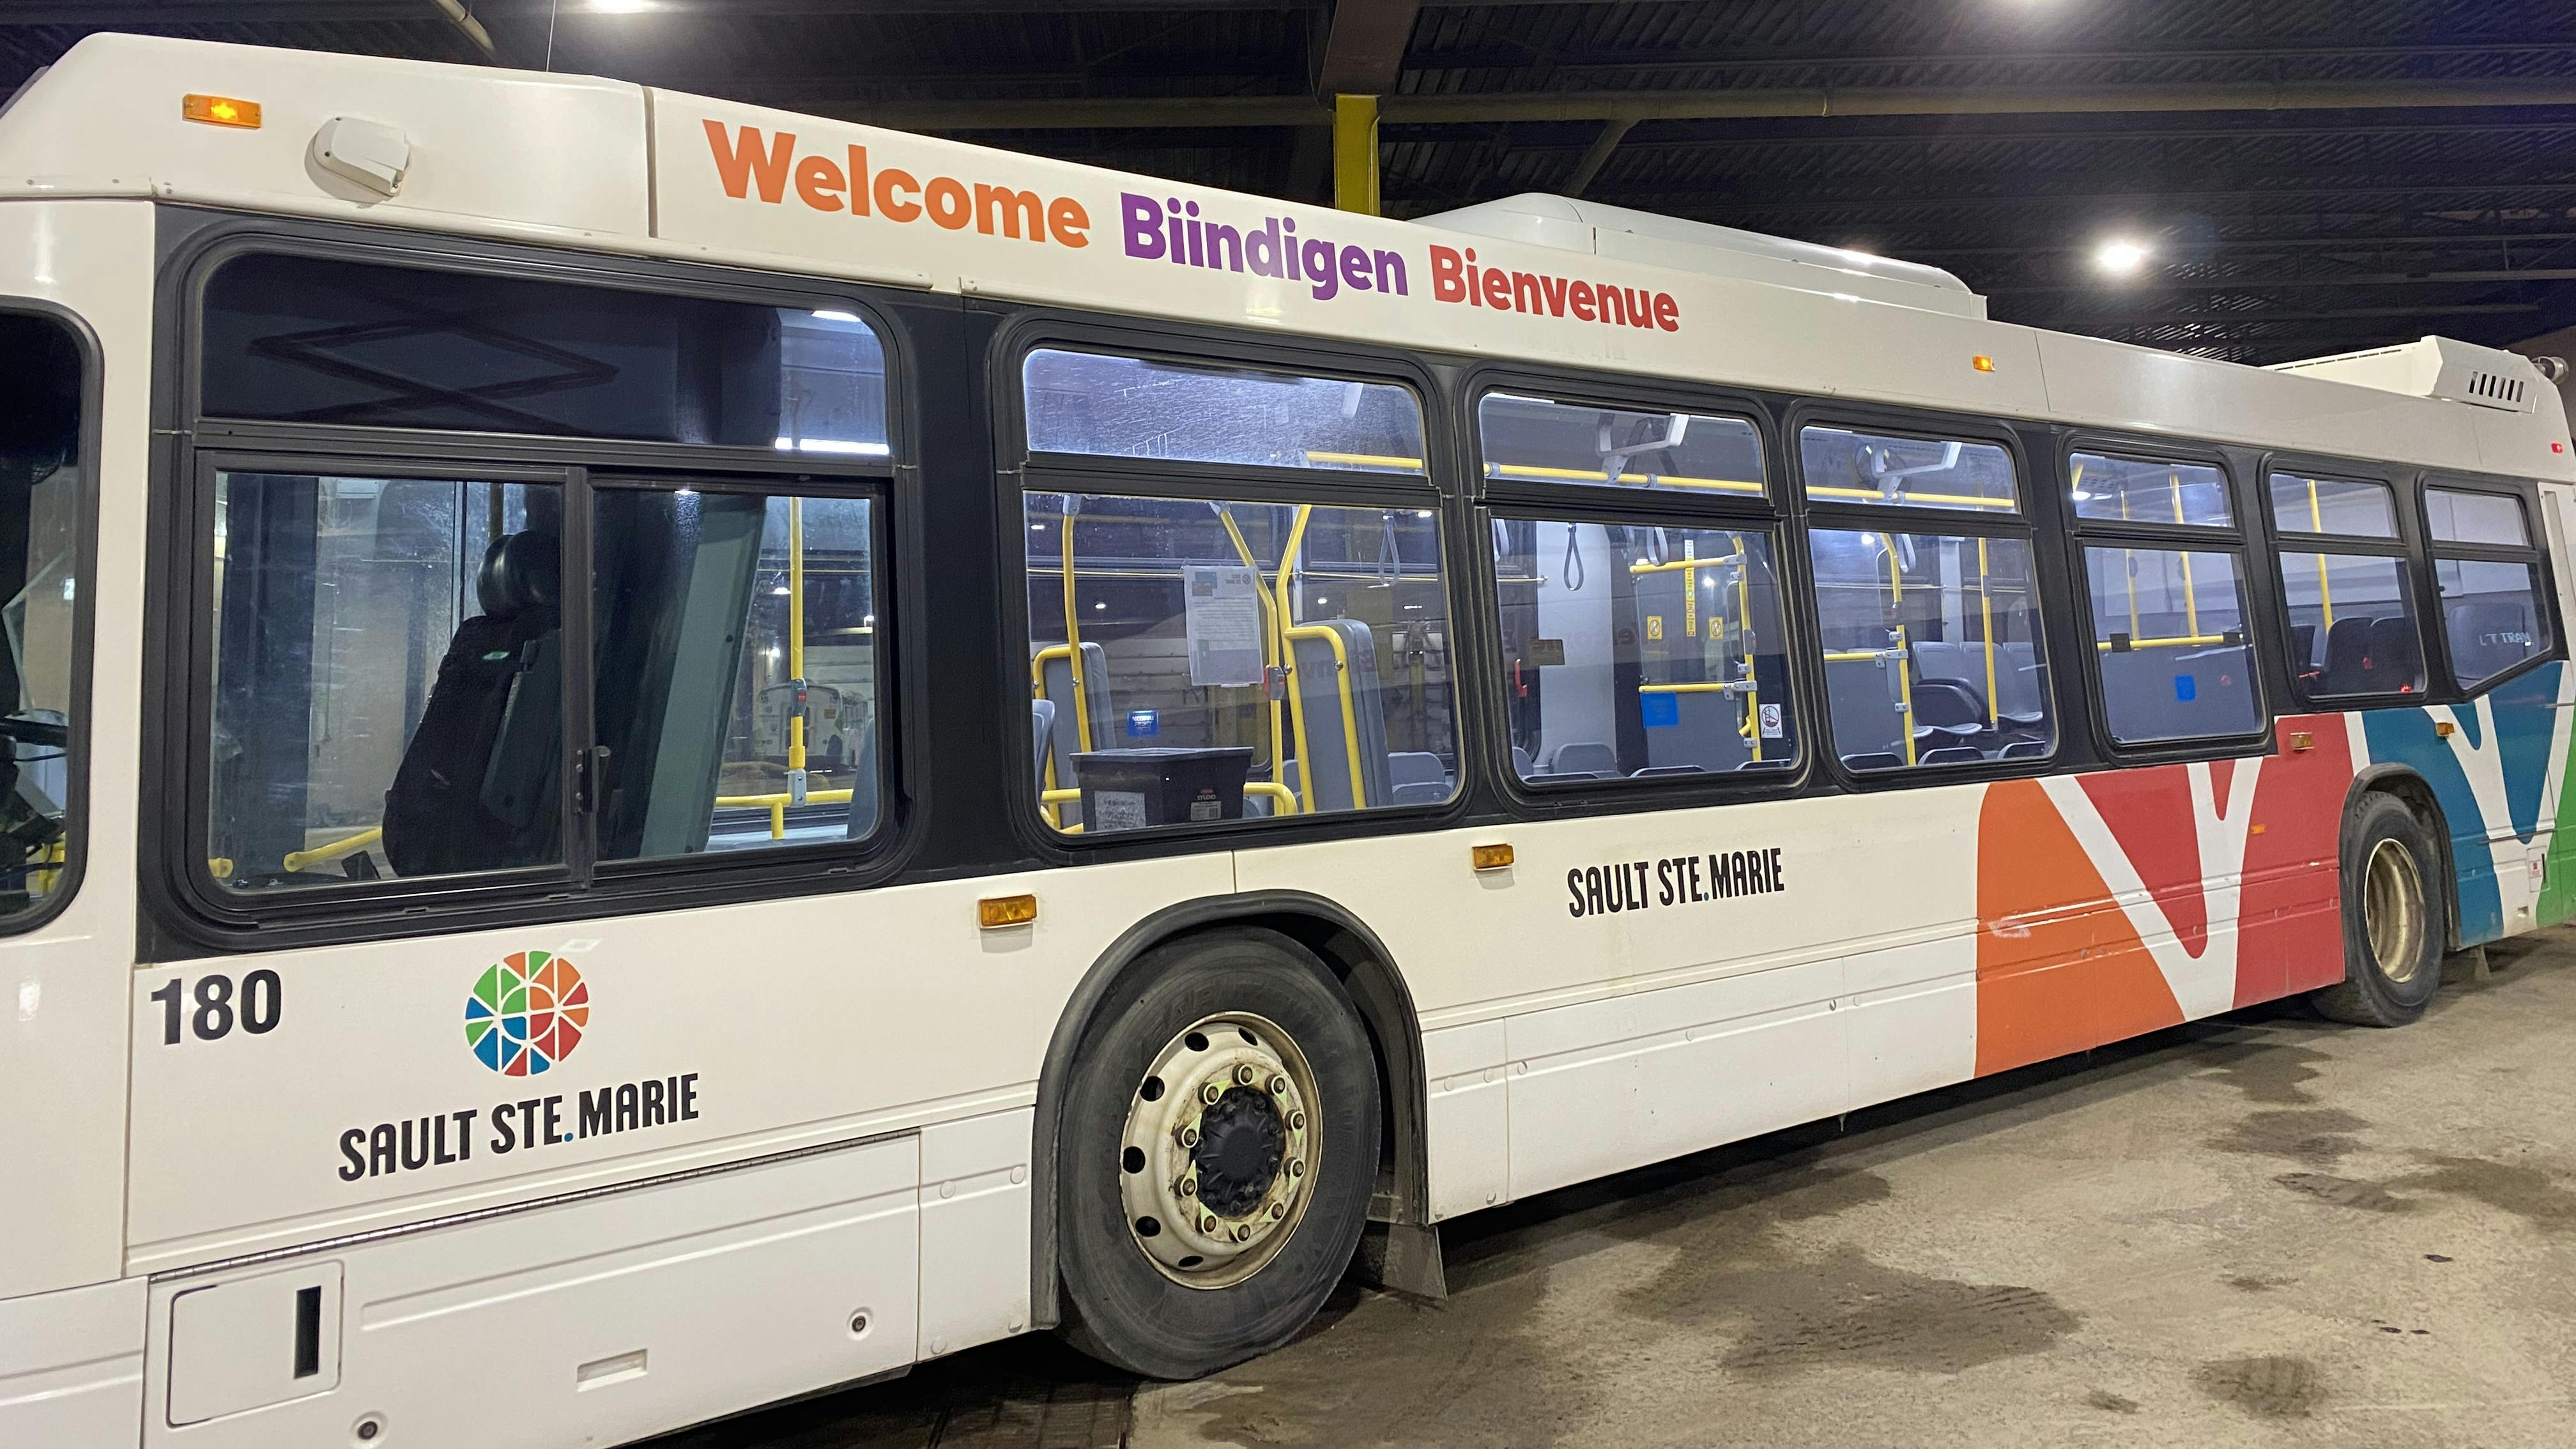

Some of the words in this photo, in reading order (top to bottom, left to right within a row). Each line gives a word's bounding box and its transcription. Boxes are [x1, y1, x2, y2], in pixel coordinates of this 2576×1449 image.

[703, 119, 1091, 249] Welcome
[1121, 194, 1407, 300] Biindigen
[1429, 245, 1679, 332] Bienvenue
[1567, 861, 1649, 918] SAULT
[151, 969, 282, 1045] 180
[339, 1109, 477, 1182] SAULT
